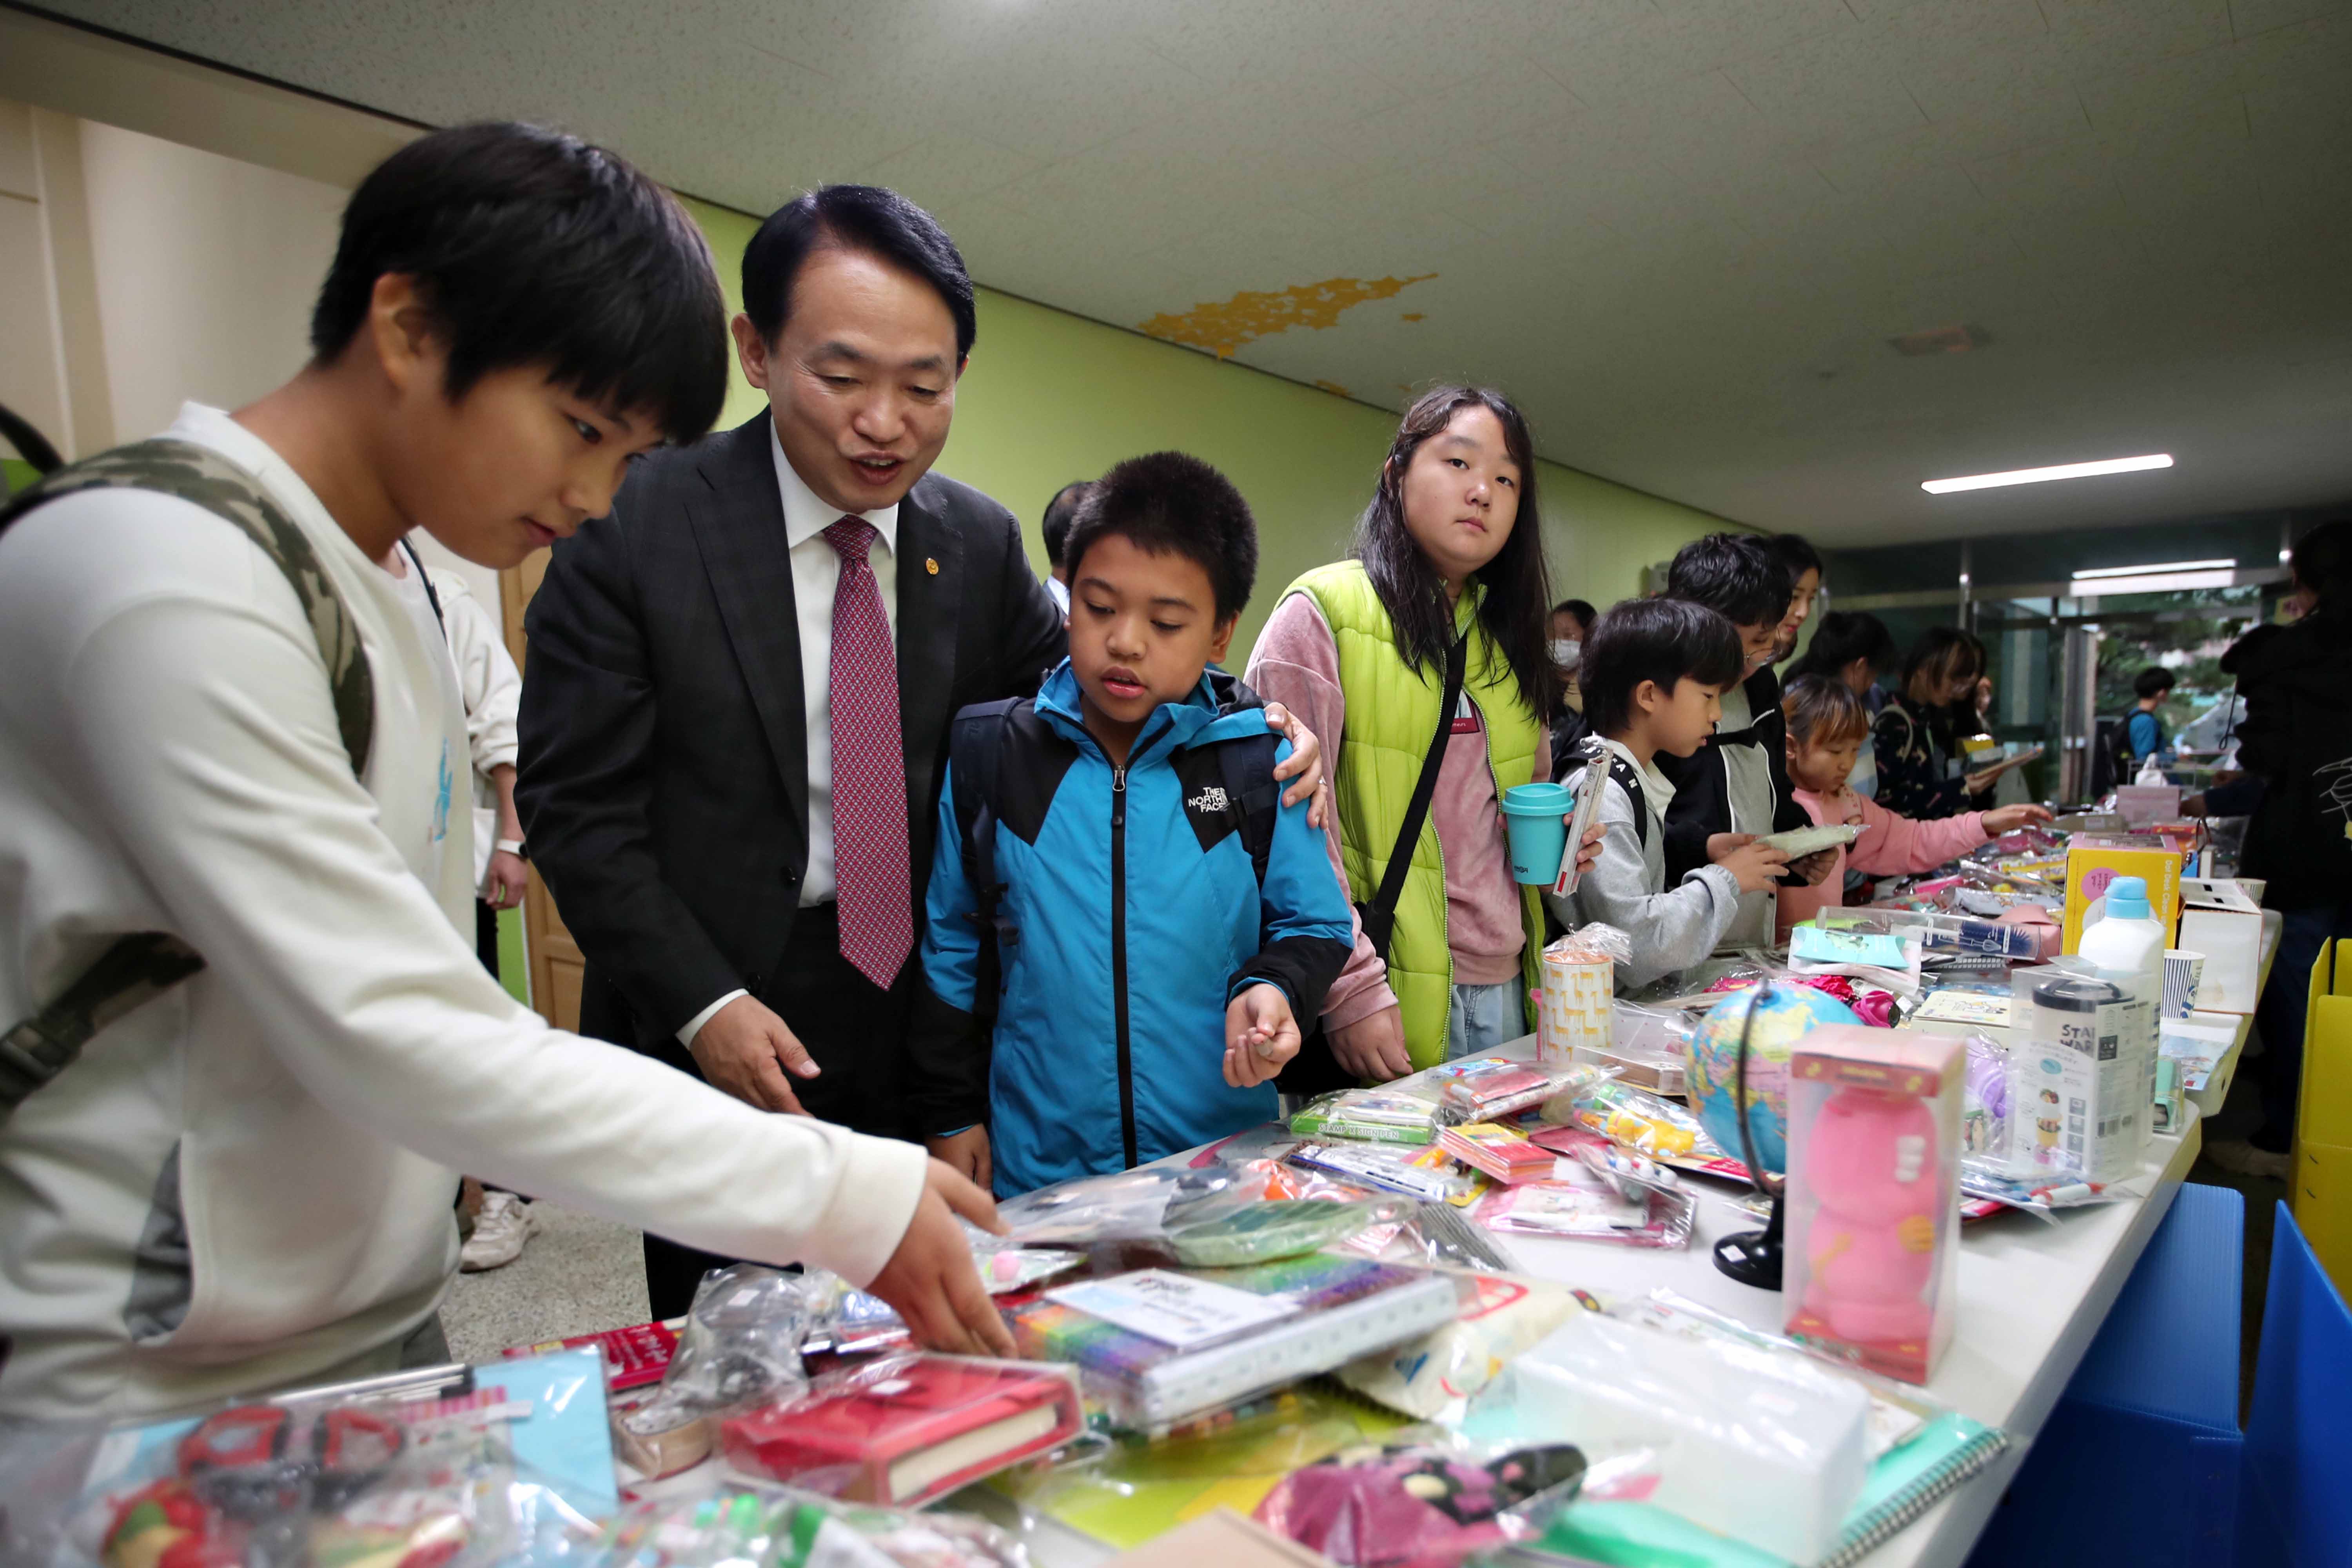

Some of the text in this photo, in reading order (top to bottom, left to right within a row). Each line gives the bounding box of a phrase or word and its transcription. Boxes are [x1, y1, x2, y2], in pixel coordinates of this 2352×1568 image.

[1203, 787, 1221, 795] THE
[1188, 795, 1222, 807] NORTH
[1200, 802, 1224, 813] FACE
[2062, 1024, 2095, 1039] STA
[1318, 1123, 1347, 1133] STAMP
[1357, 1127, 1380, 1137] SIGN
[1380, 1130, 1399, 1139] PEN
